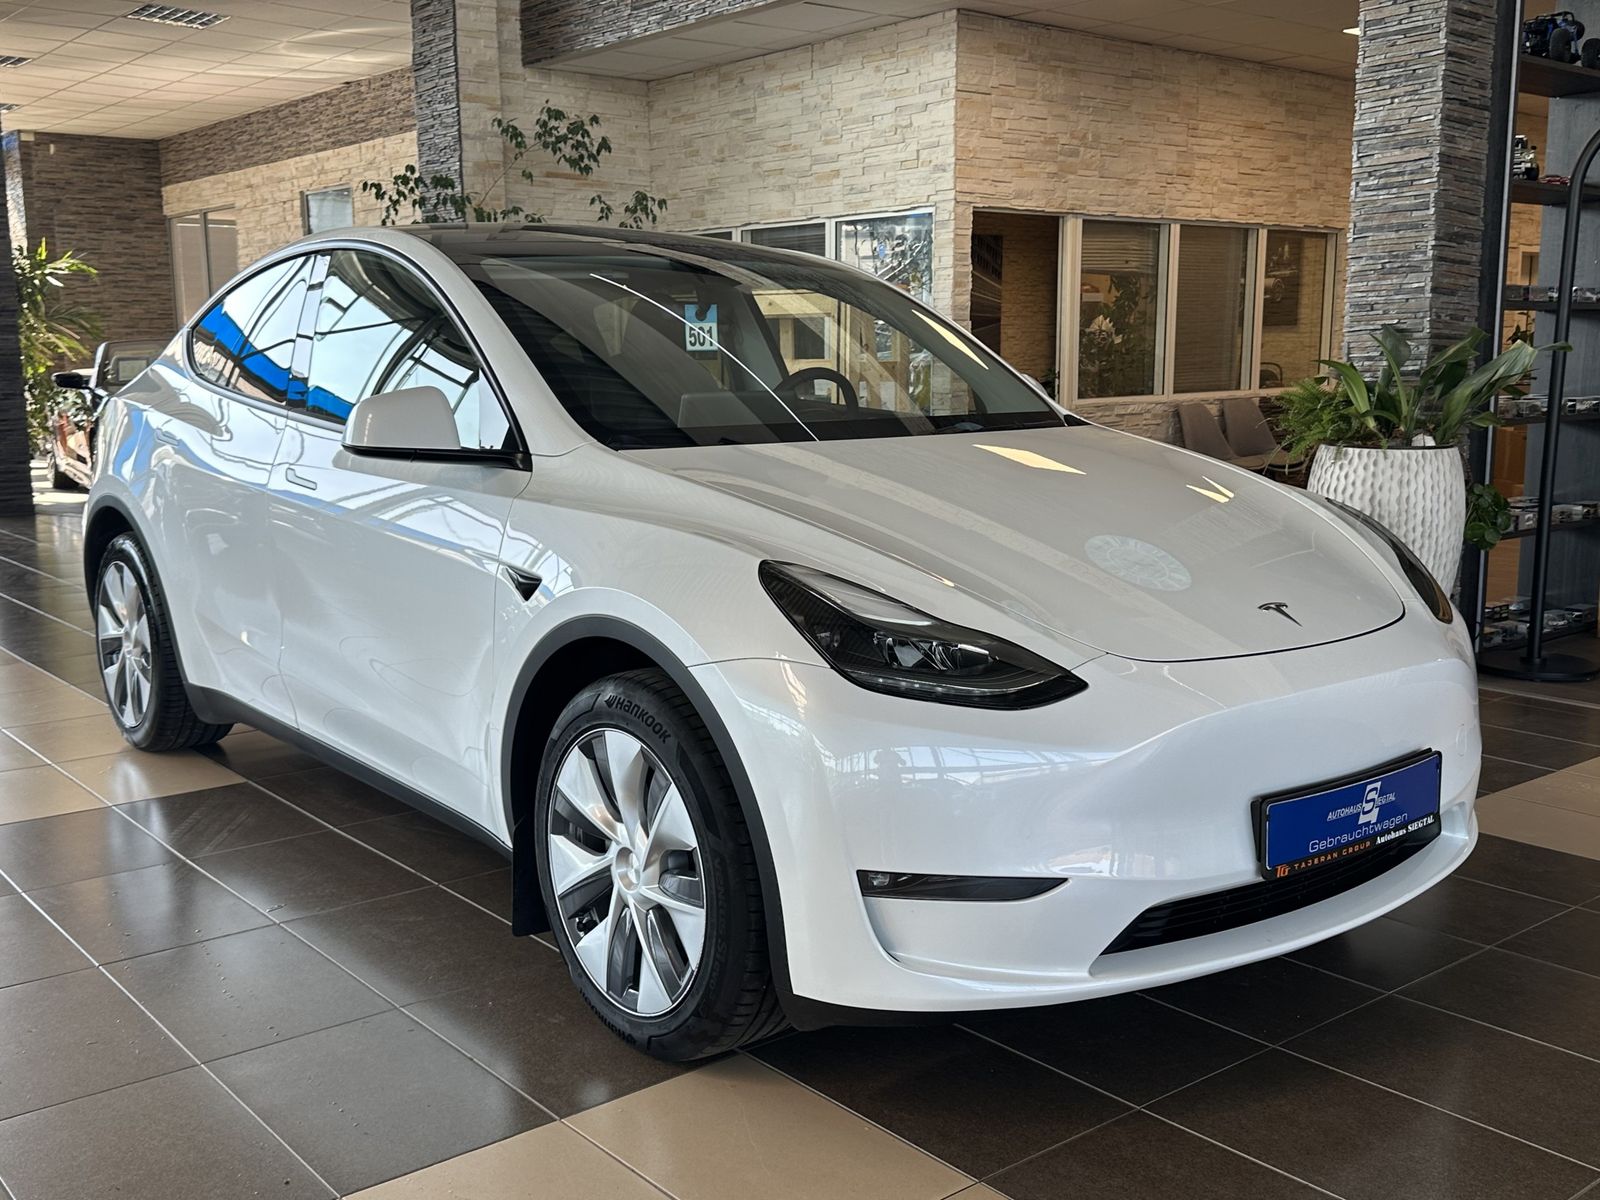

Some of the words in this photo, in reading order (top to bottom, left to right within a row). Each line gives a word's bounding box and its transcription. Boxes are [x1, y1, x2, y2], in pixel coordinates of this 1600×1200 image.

[689, 326, 713, 347] 501
[1327, 803, 1362, 822] AUTOHAUS
[1309, 813, 1408, 853] Gebrauchtwagen
[1376, 828, 1407, 845] Autohaus
[1407, 815, 1435, 833] SIEGTAL
[1293, 852, 1338, 870] TAJERAN
[1342, 841, 1372, 856] GROUP
